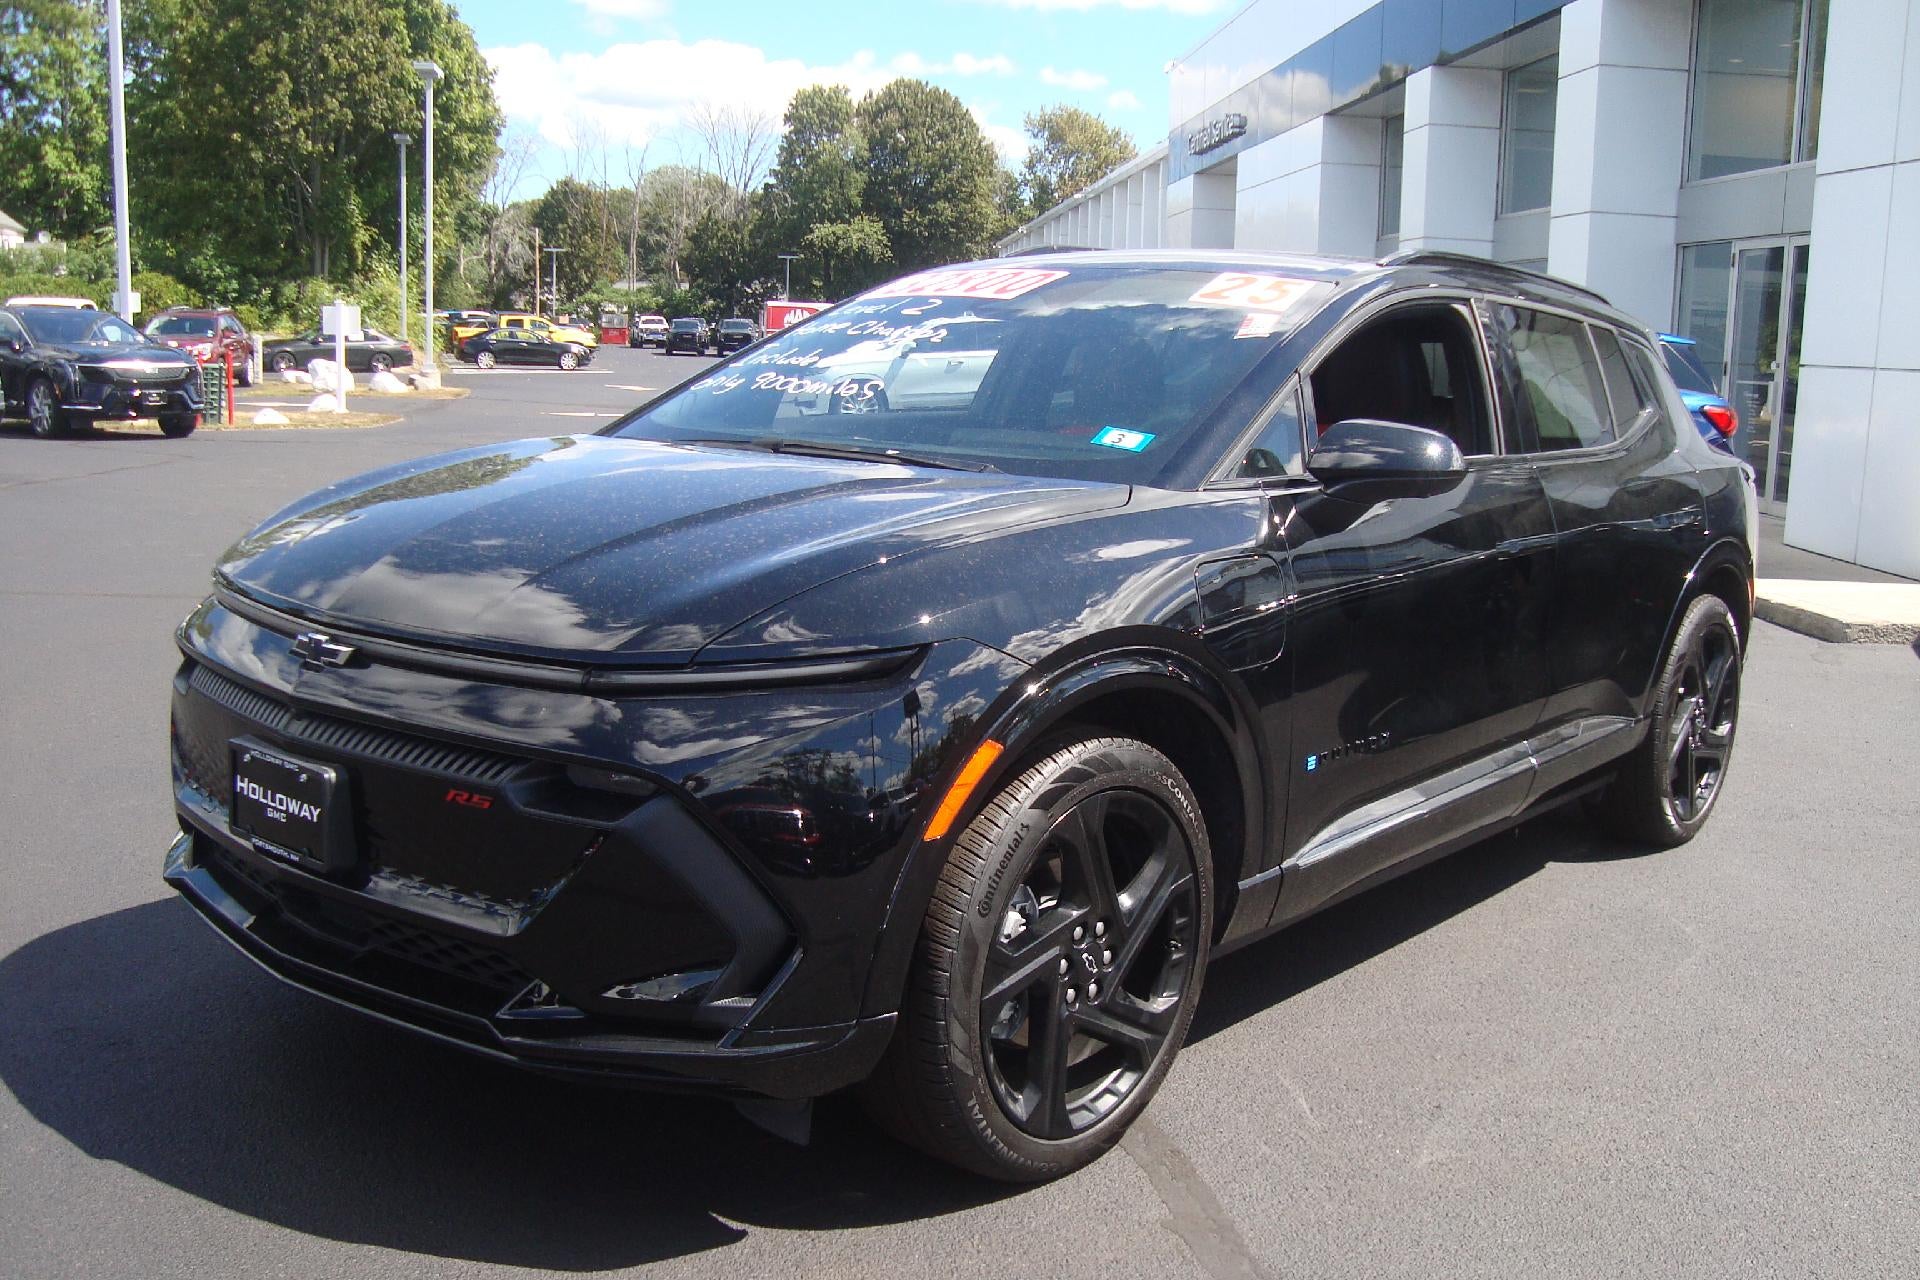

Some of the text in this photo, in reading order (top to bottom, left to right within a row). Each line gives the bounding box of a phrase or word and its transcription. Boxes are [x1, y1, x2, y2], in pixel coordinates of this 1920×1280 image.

[1199, 276, 1304, 305] 25
[901, 299, 943, 315] 2
[236, 774, 322, 823] HOLLOWAY
[444, 789, 494, 809] RS
[267, 807, 287, 823] GMC
[977, 830, 1024, 918] Continental
